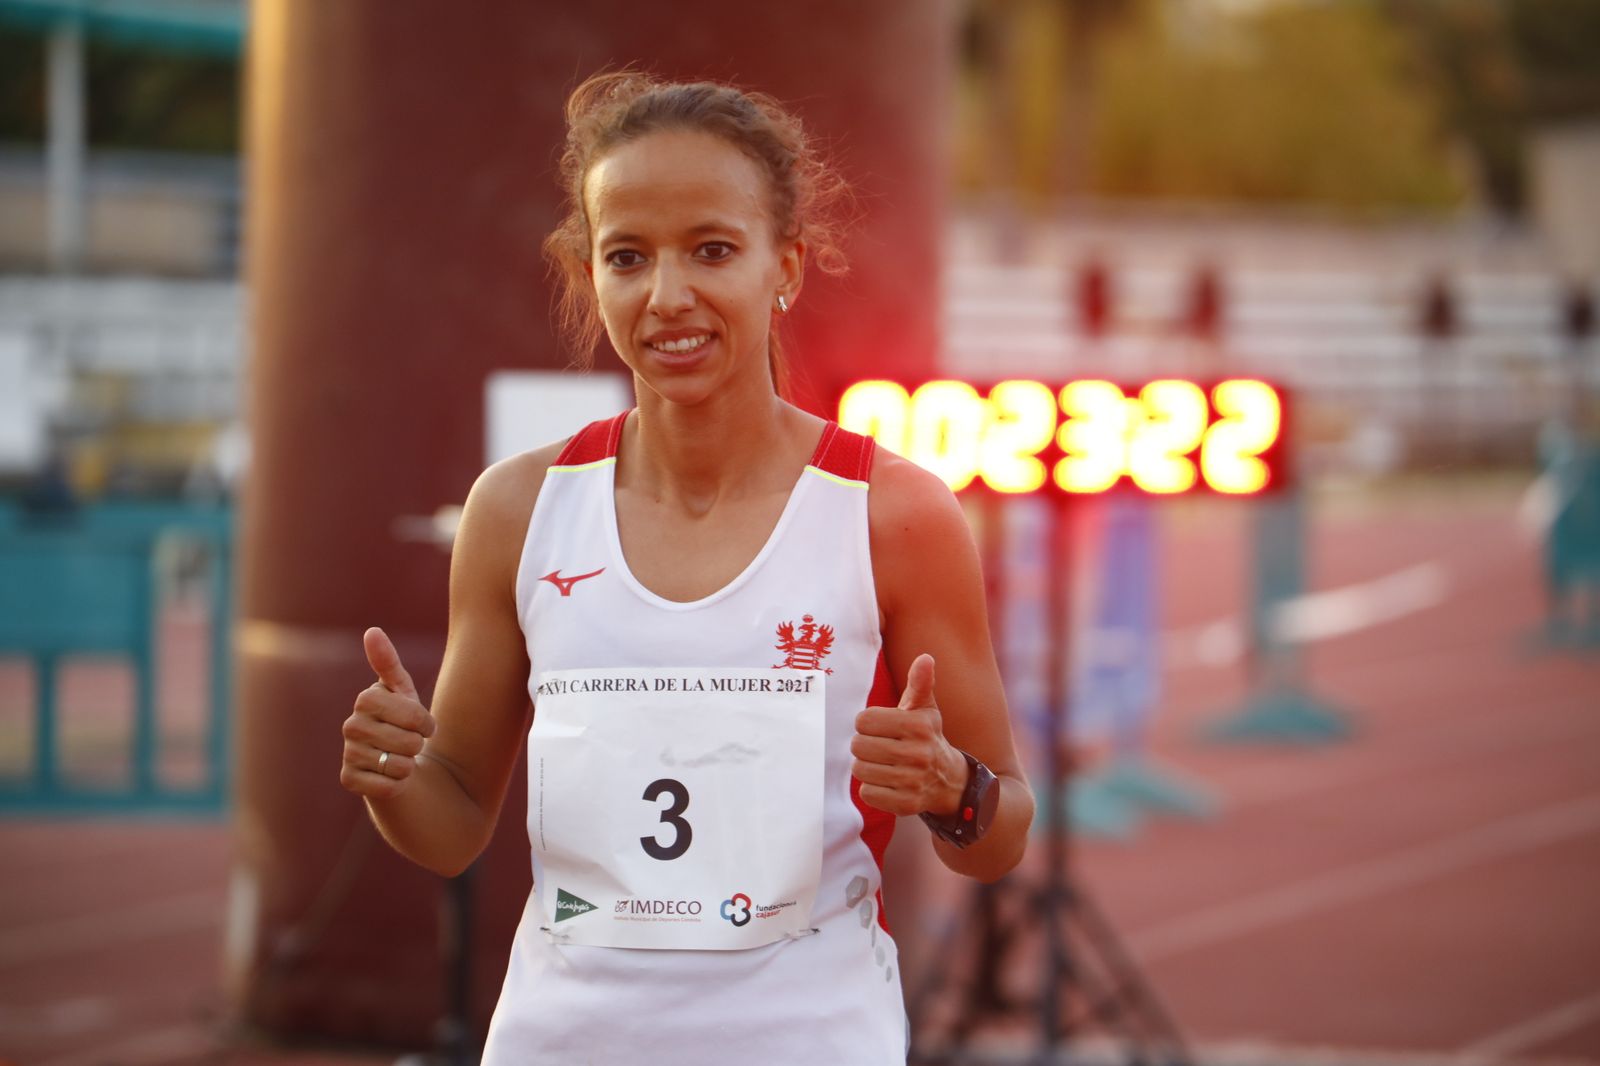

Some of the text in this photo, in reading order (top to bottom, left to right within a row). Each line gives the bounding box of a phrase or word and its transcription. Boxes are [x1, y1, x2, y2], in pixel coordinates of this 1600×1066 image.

[570, 678, 649, 693] CARRERA
[654, 678, 677, 692] DE
[682, 678, 705, 692] LA
[710, 678, 772, 692] MUJER
[776, 679, 811, 693] 2021
[640, 778, 693, 861] 3
[631, 900, 702, 915] IMDECO
